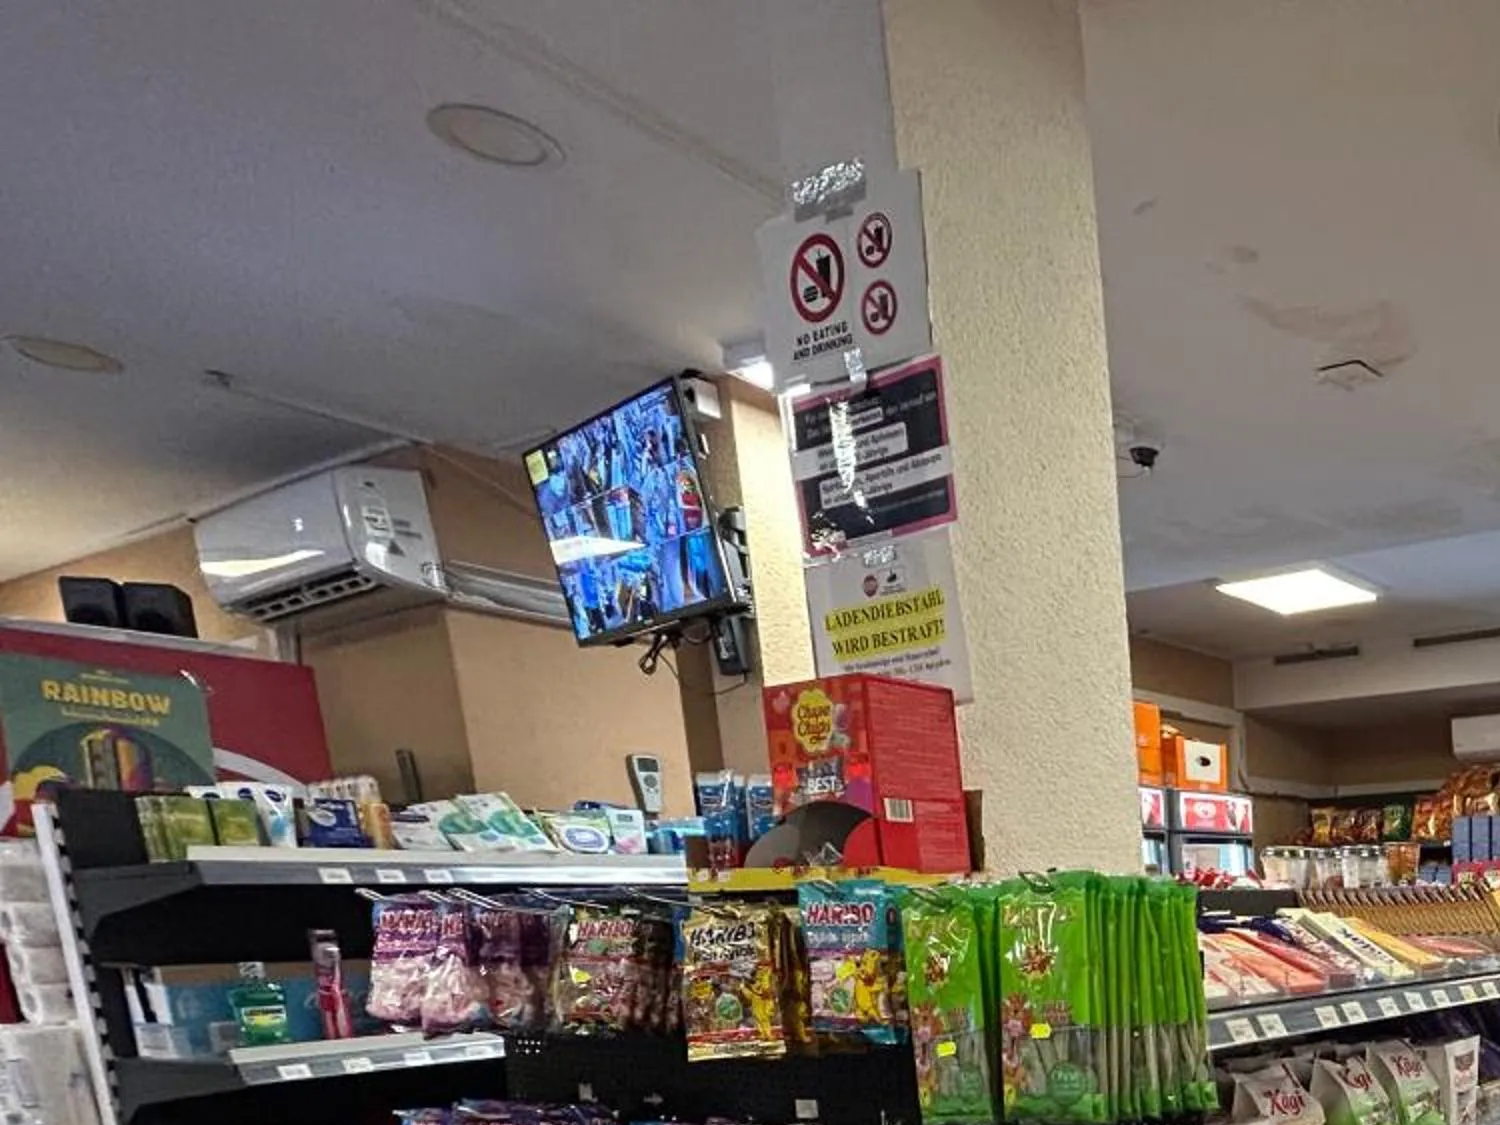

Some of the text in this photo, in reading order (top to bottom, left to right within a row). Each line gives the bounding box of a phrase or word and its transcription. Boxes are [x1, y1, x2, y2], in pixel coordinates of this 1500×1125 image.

[796, 320, 849, 347] NO EATING
[812, 333, 853, 356] DRINKING
[825, 588, 945, 631] LADENDIEBSTAHL
[832, 618, 945, 656] WIRD BESTRAFT!
[40, 679, 172, 715] RAINBOW
[807, 776, 838, 794] BEST
[804, 902, 875, 926] HARIBO
